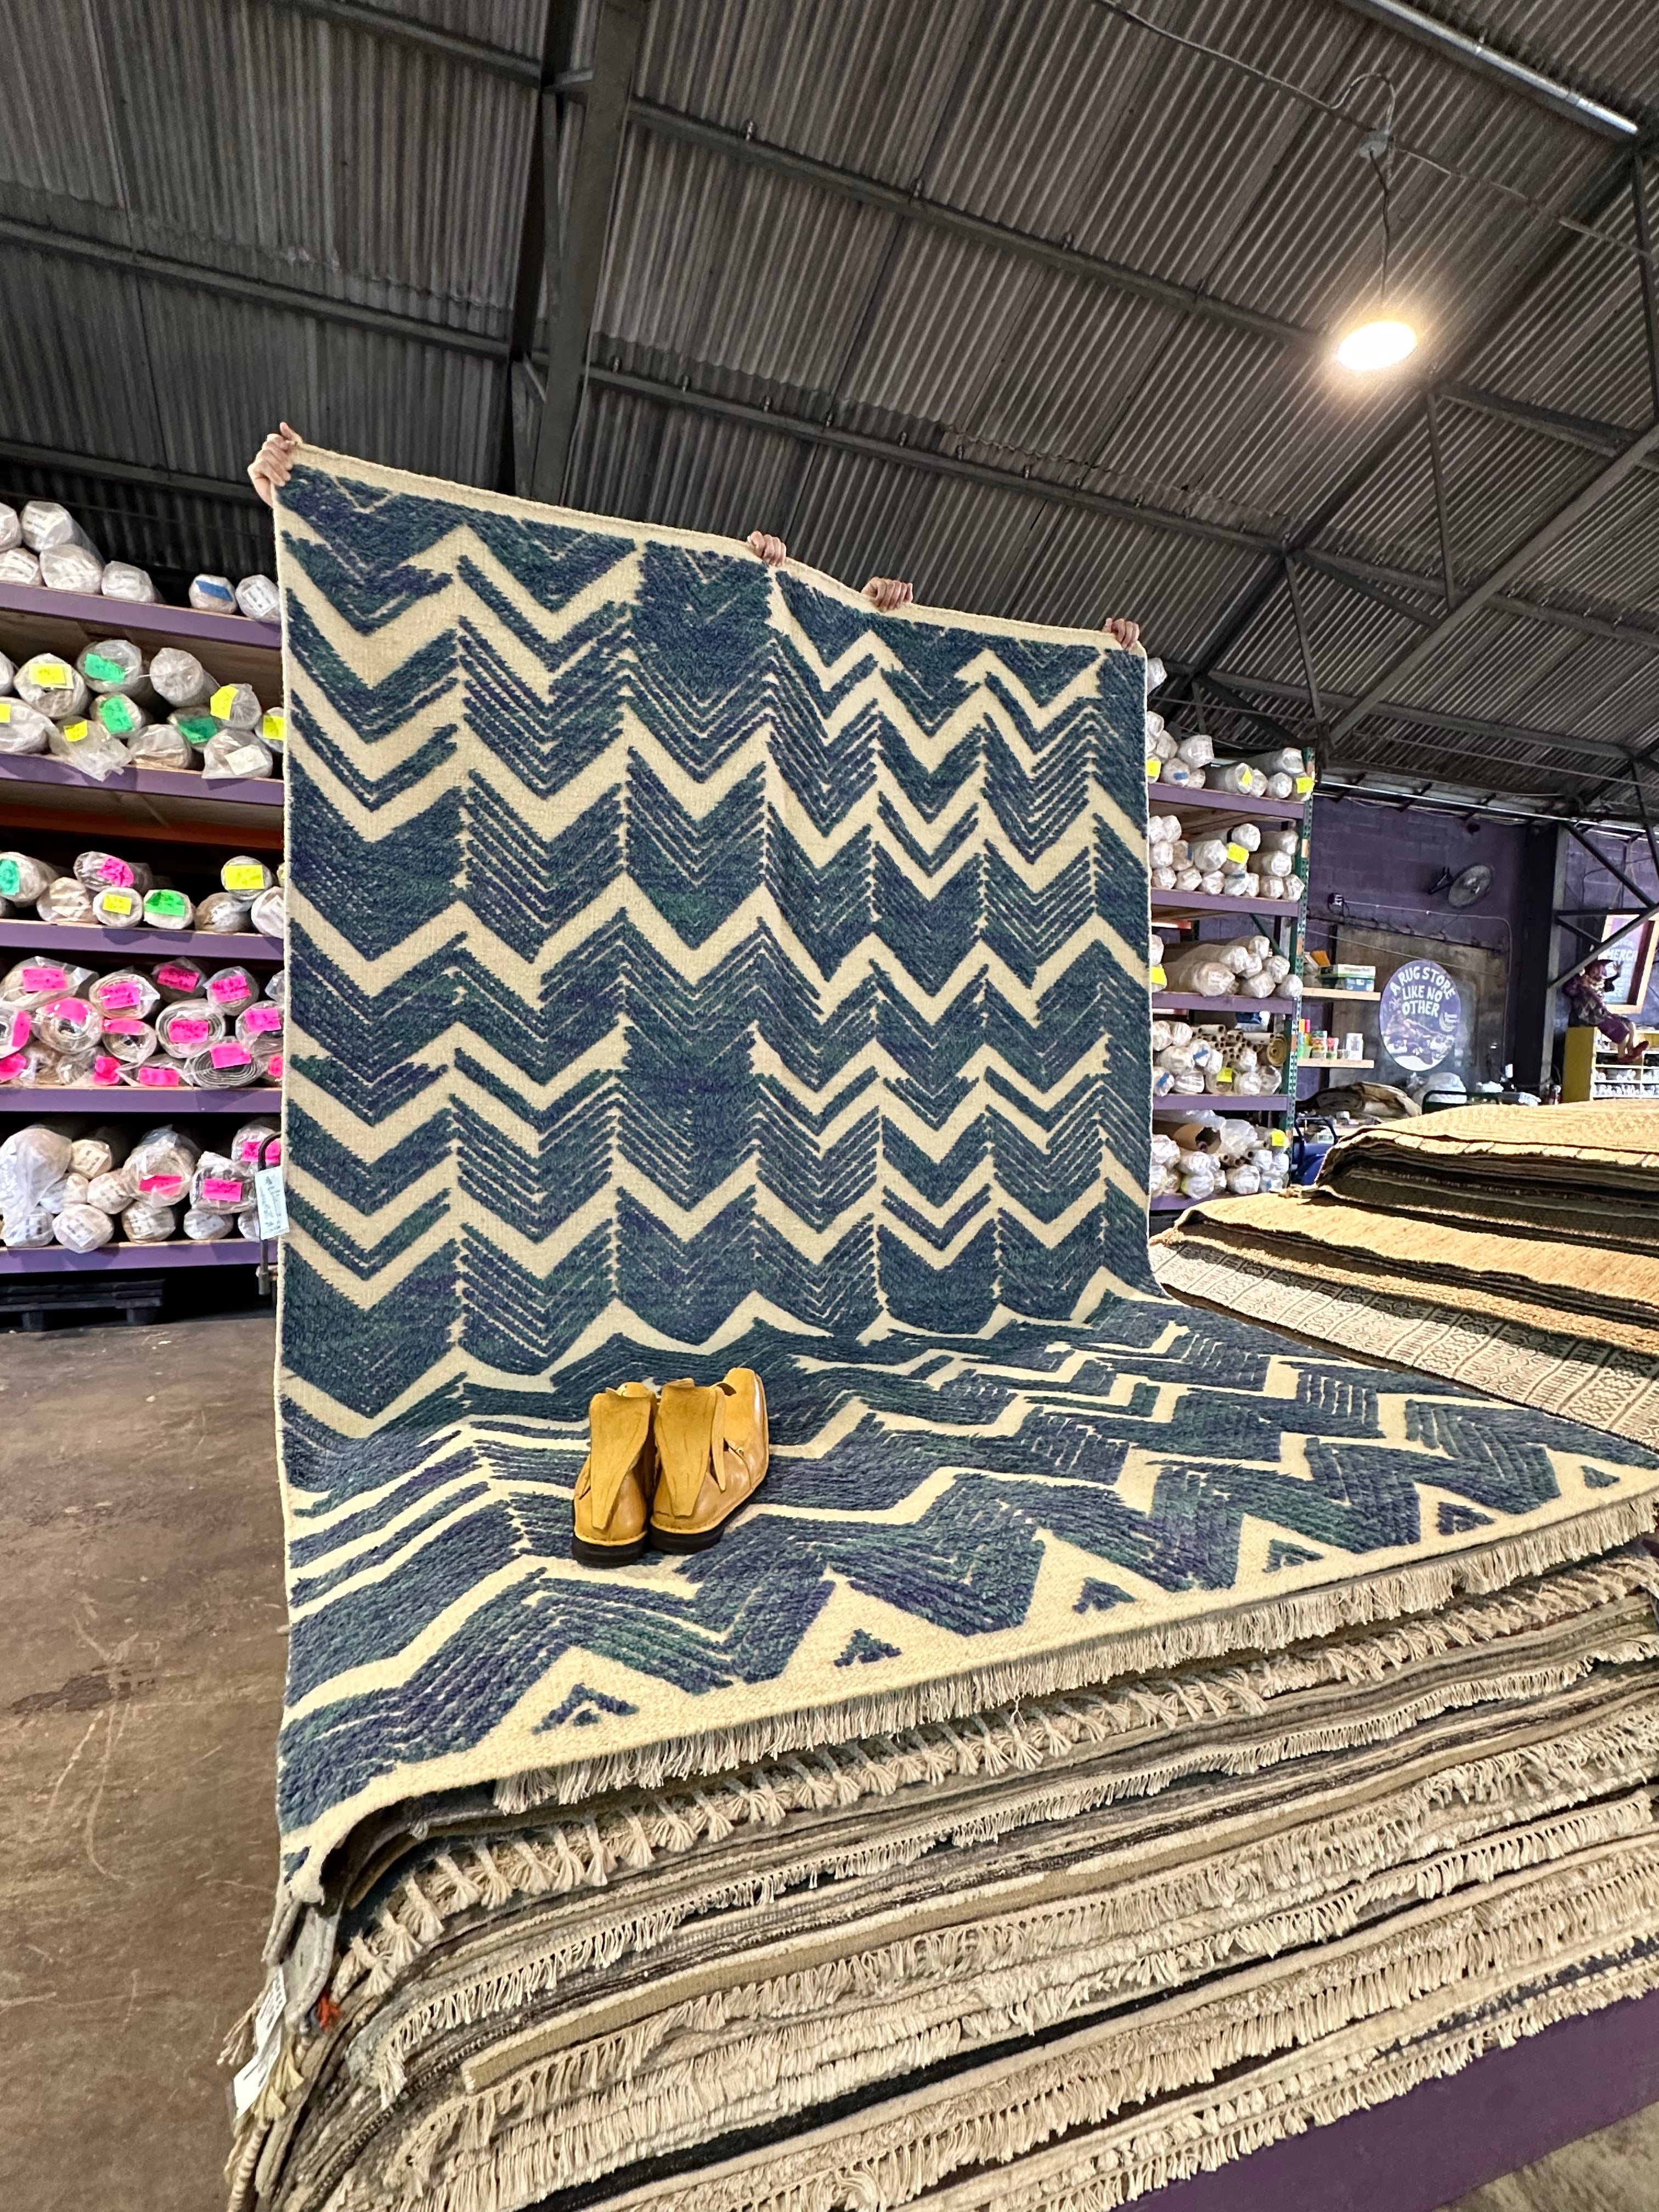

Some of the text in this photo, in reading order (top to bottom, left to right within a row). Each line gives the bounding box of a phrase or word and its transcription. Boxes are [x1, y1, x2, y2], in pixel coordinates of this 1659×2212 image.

[1390, 966, 1456, 1000] A RUG STORE
[1402, 985, 1443, 1002] LIKE NO
[1402, 1000, 1440, 1018] OTHER
